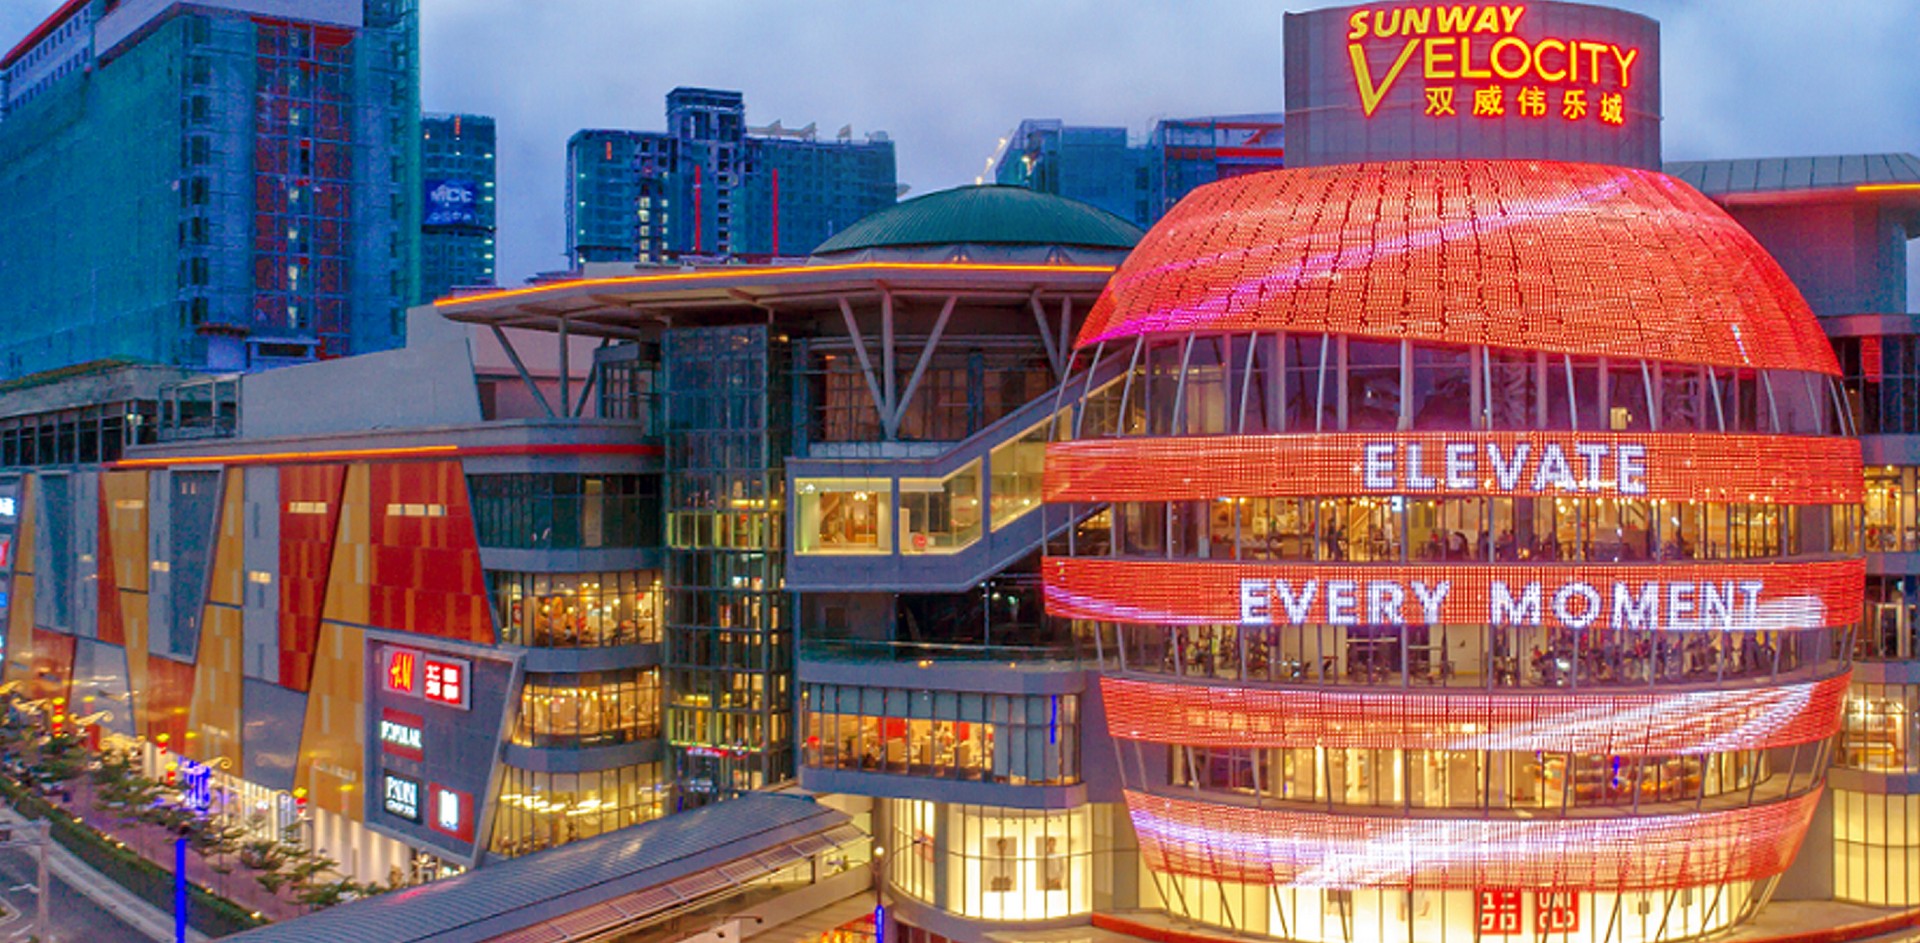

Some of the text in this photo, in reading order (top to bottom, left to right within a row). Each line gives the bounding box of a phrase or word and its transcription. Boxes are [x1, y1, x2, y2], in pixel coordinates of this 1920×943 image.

[1349, 6, 1524, 39] SUNWAY
[1349, 37, 1636, 116] VELOCITY
[1425, 85, 1623, 124] 双威伟乐城
[1364, 443, 1647, 493] ELEVATE
[1240, 579, 1764, 631] EVERY MOMENT
